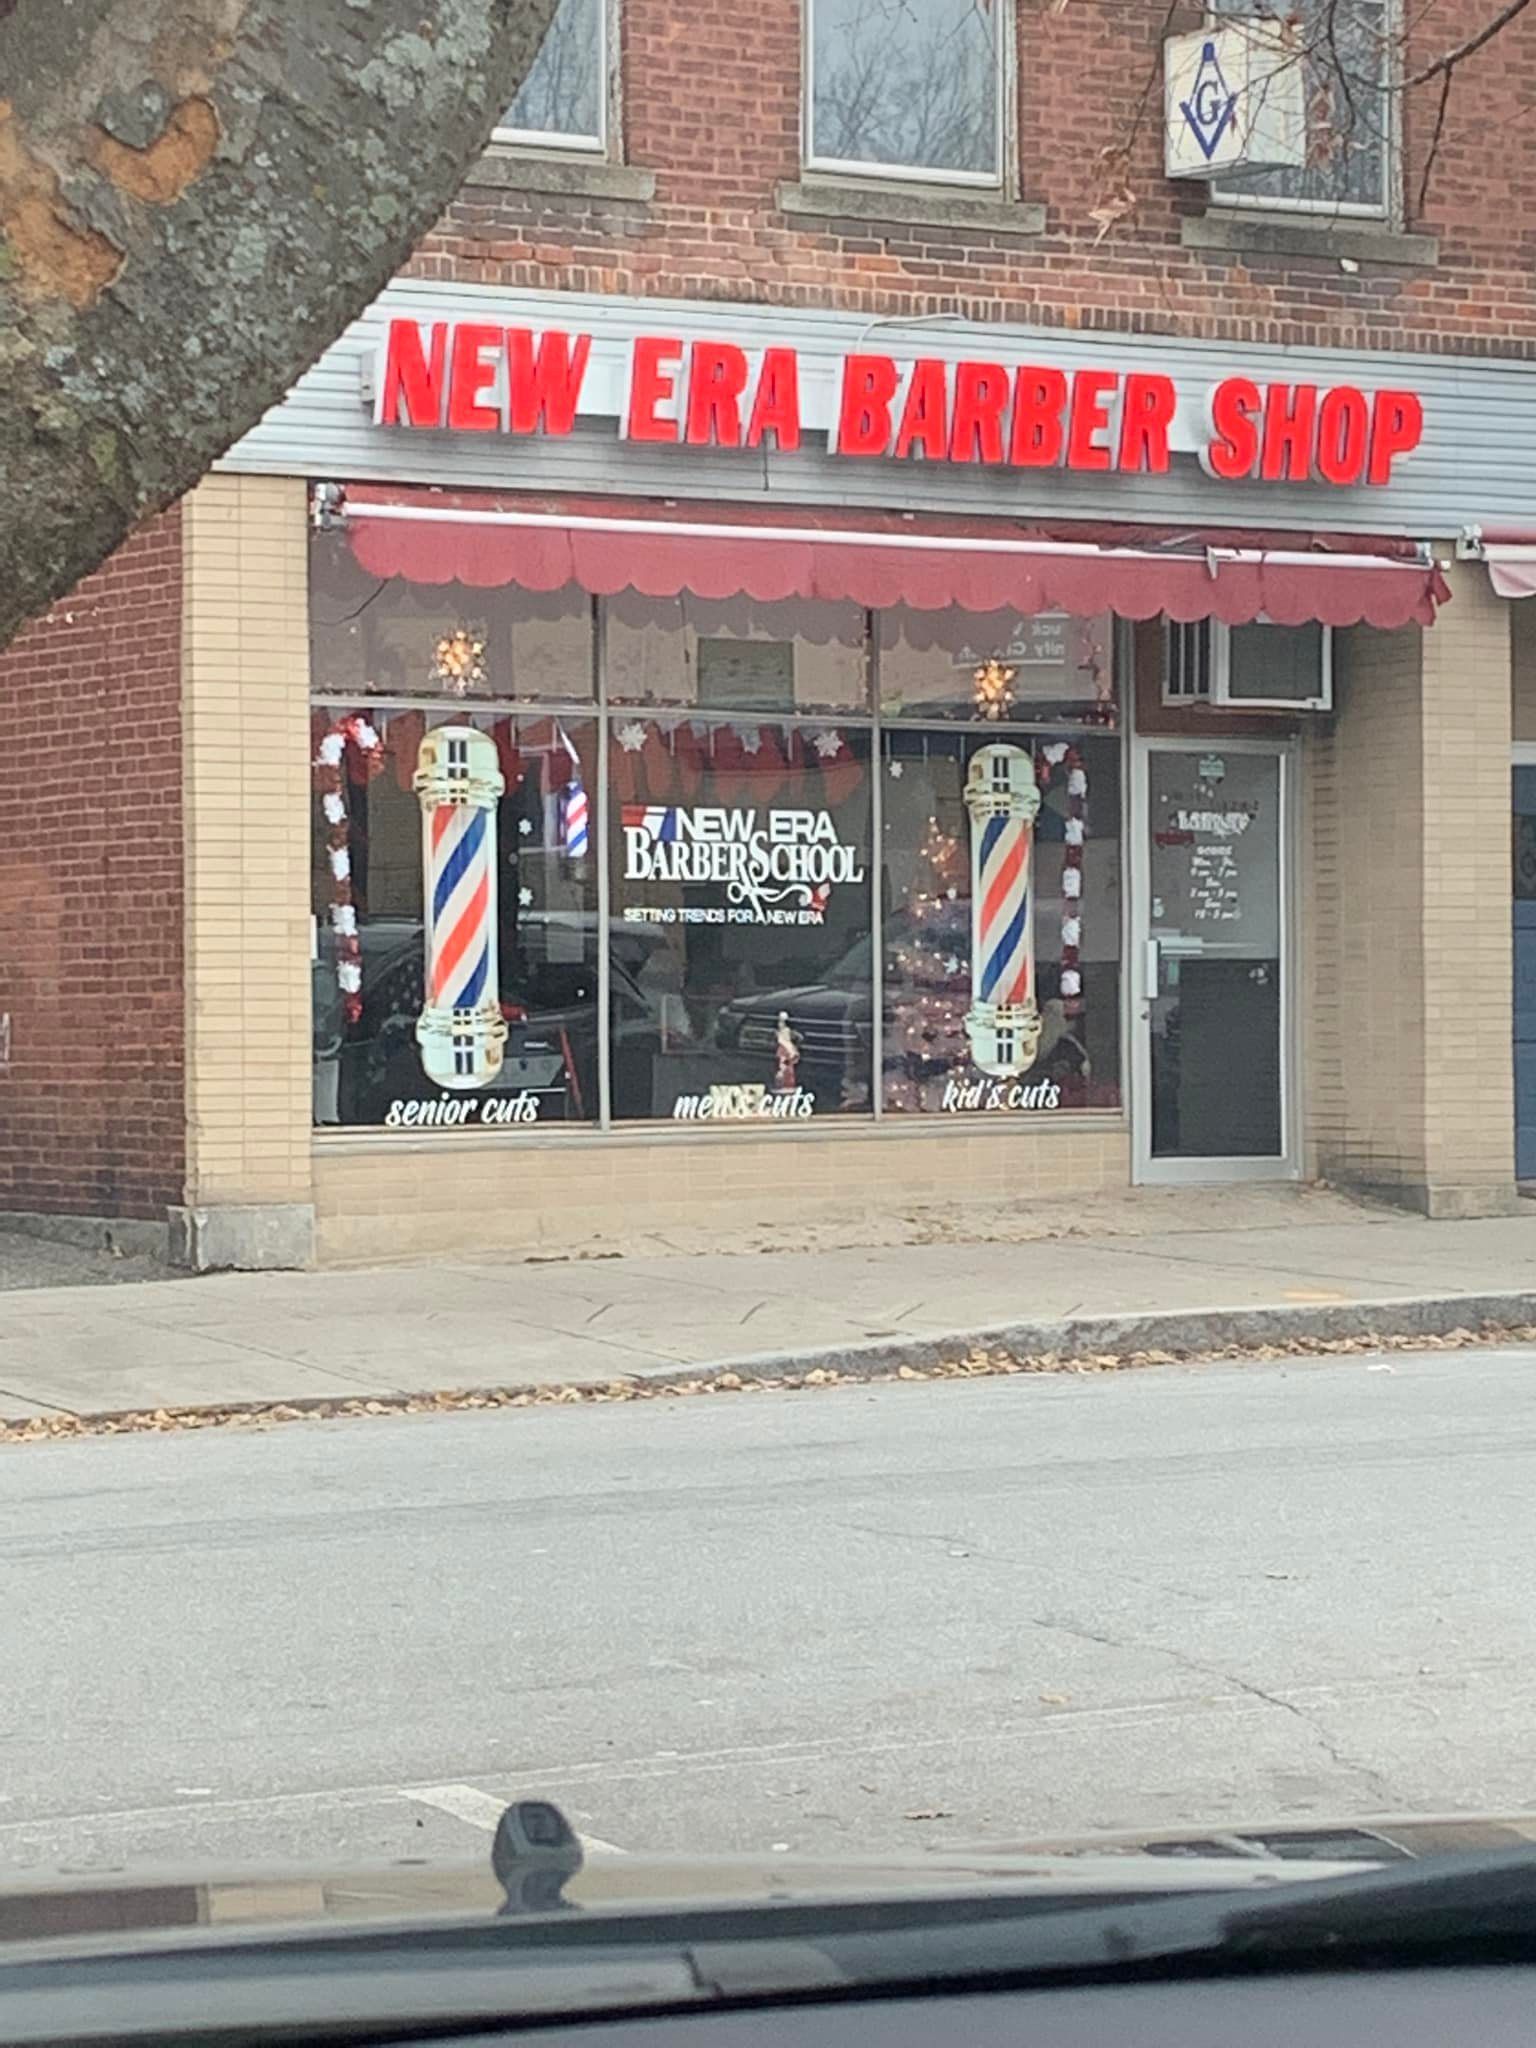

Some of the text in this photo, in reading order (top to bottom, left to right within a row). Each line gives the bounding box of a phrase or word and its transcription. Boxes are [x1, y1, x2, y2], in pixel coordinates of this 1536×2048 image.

[1196, 80, 1221, 126] G
[378, 318, 1423, 486] NEW ERA BARBER SHOP
[675, 807, 838, 844] NEW ERA
[623, 907, 676, 924] SETTING
[678, 908, 725, 924] TRENDS
[727, 908, 752, 924] FOR
[767, 910, 798, 925] NEW
[798, 910, 825, 925] ERA
[385, 1091, 540, 1126] senior cuts
[757, 1085, 816, 1119] cuts
[941, 1078, 1061, 1112] kid's cuts
